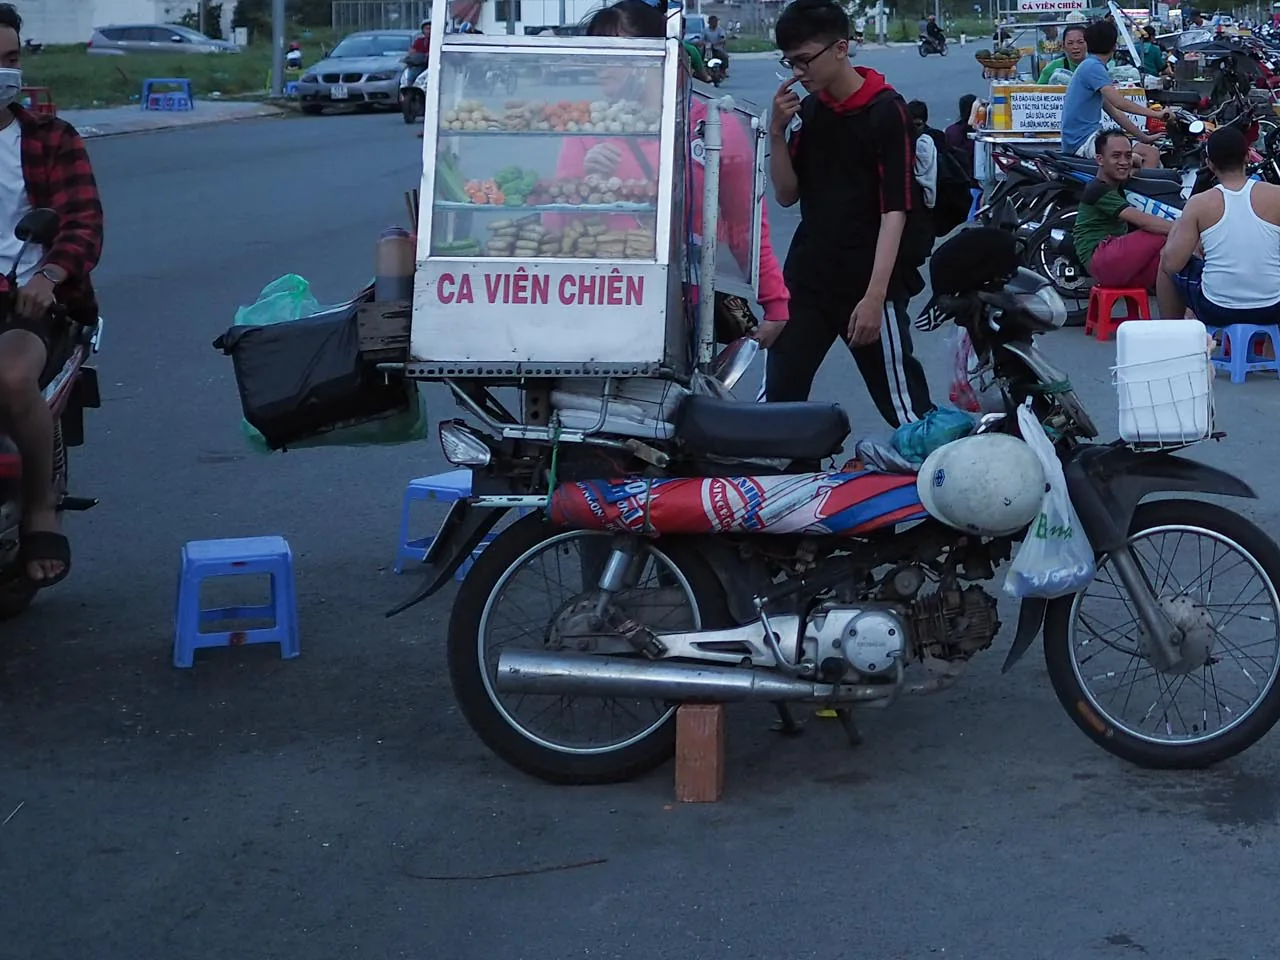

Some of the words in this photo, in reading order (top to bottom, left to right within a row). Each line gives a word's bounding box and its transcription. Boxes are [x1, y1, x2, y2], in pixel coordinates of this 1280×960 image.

[437, 273, 474, 305] CA
[484, 266, 550, 305] VIÊN
[558, 267, 645, 306] CHIÊN
